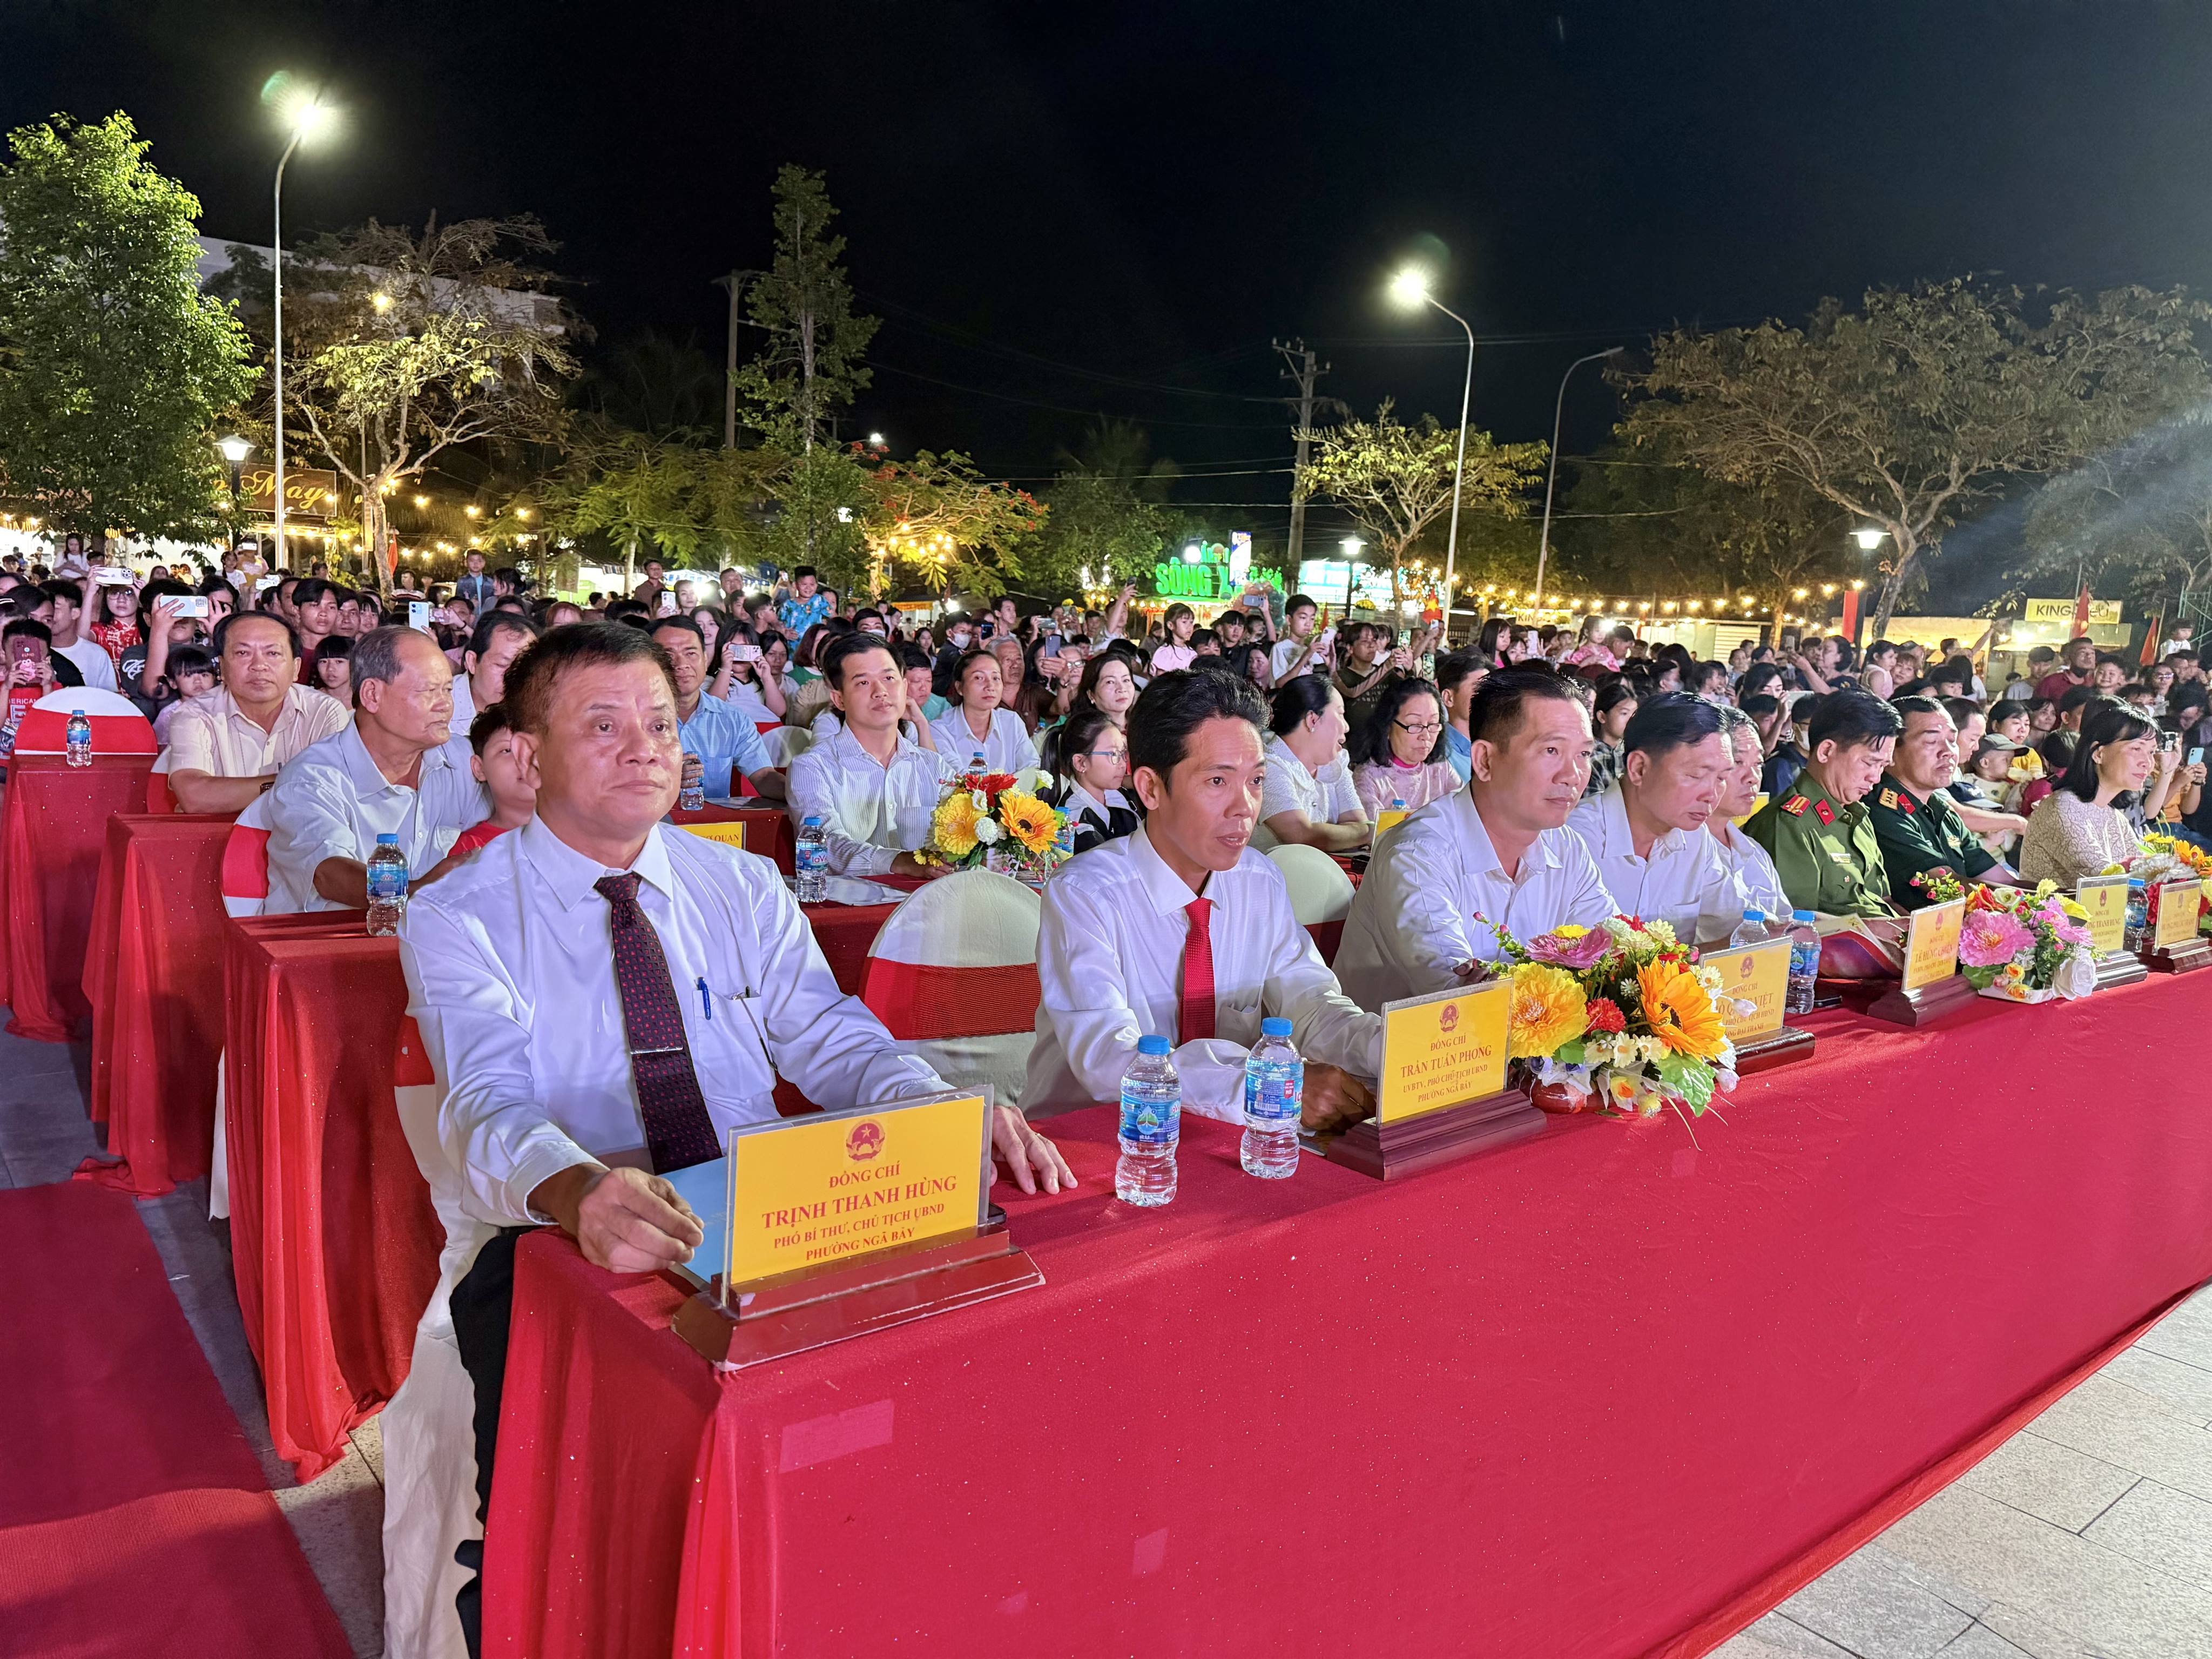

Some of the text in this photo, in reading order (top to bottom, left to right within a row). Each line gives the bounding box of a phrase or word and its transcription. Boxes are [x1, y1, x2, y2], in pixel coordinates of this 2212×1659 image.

[1156, 557, 1212, 596] SÔNG
[1518, 613, 1535, 622] KIN
[714, 834, 739, 842] QUAN
[1453, 1032, 1466, 1046] CHÍ
[1400, 1045, 1492, 1078] TRẦN TUẤN PHONG
[1455, 1068, 1470, 1080] TỊCH
[1472, 1064, 1488, 1075] UBND
[829, 1161, 900, 1189] ĐỒNG CHÍ
[761, 1175, 957, 1229] TRỊNH THANH HÙNG
[774, 1203, 945, 1249] PHÓ BÍ THƯ, CHỦ TỊCH UBND
[806, 1239, 860, 1261] PHƯỜNG
[863, 1231, 888, 1249] NGÃ
